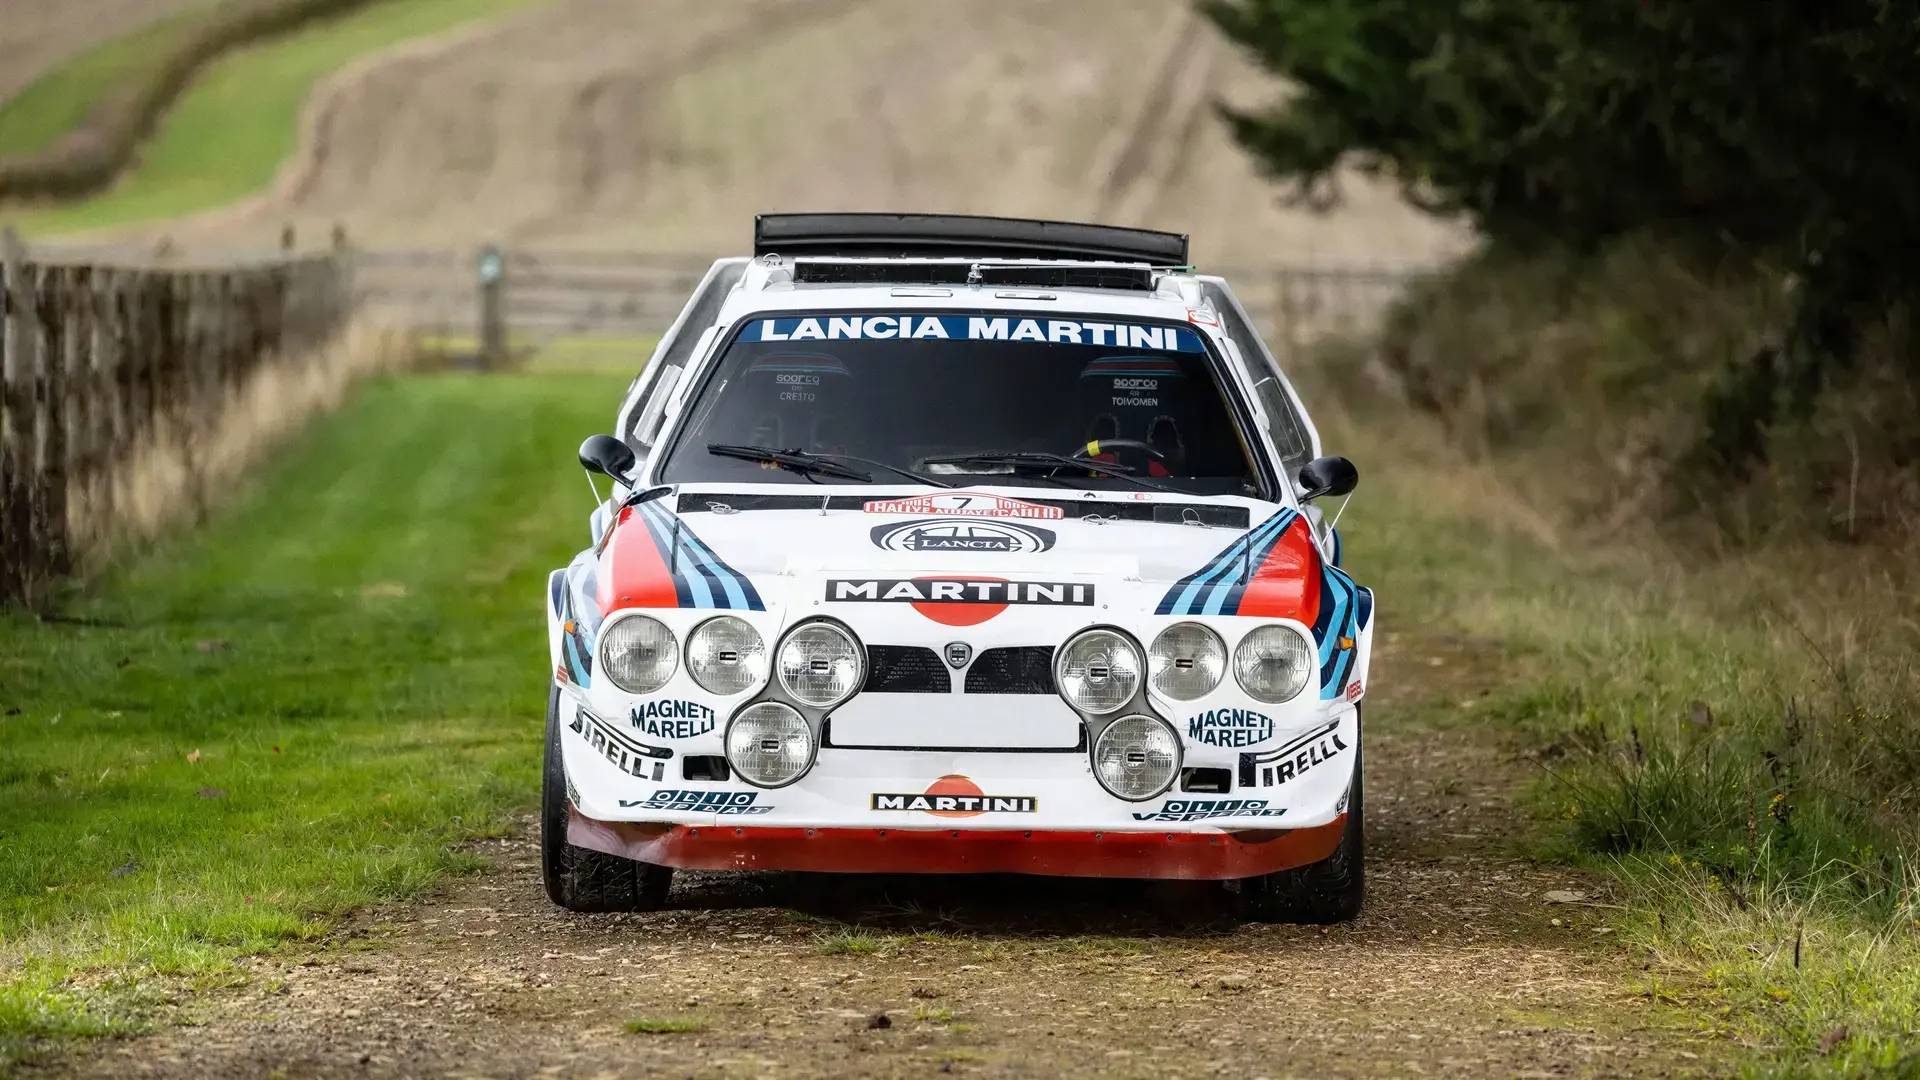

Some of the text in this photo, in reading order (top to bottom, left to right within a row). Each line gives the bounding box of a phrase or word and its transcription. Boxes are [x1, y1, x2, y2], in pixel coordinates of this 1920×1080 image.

[761, 317, 1178, 350] LANCIA MARTINI
[952, 497, 973, 509] 7
[921, 539, 1007, 549] LANCIA
[835, 581, 1085, 603] MARTINI
[631, 700, 715, 721] MAGNETI
[1189, 709, 1273, 731] MAGNETI
[631, 718, 715, 738] MARELLI
[1188, 727, 1273, 748] MARELLI
[1238, 717, 1347, 787] PIRELLI
[652, 790, 755, 805] OLIO
[877, 795, 1031, 812] MARTINI
[1165, 801, 1265, 813] OLIO
